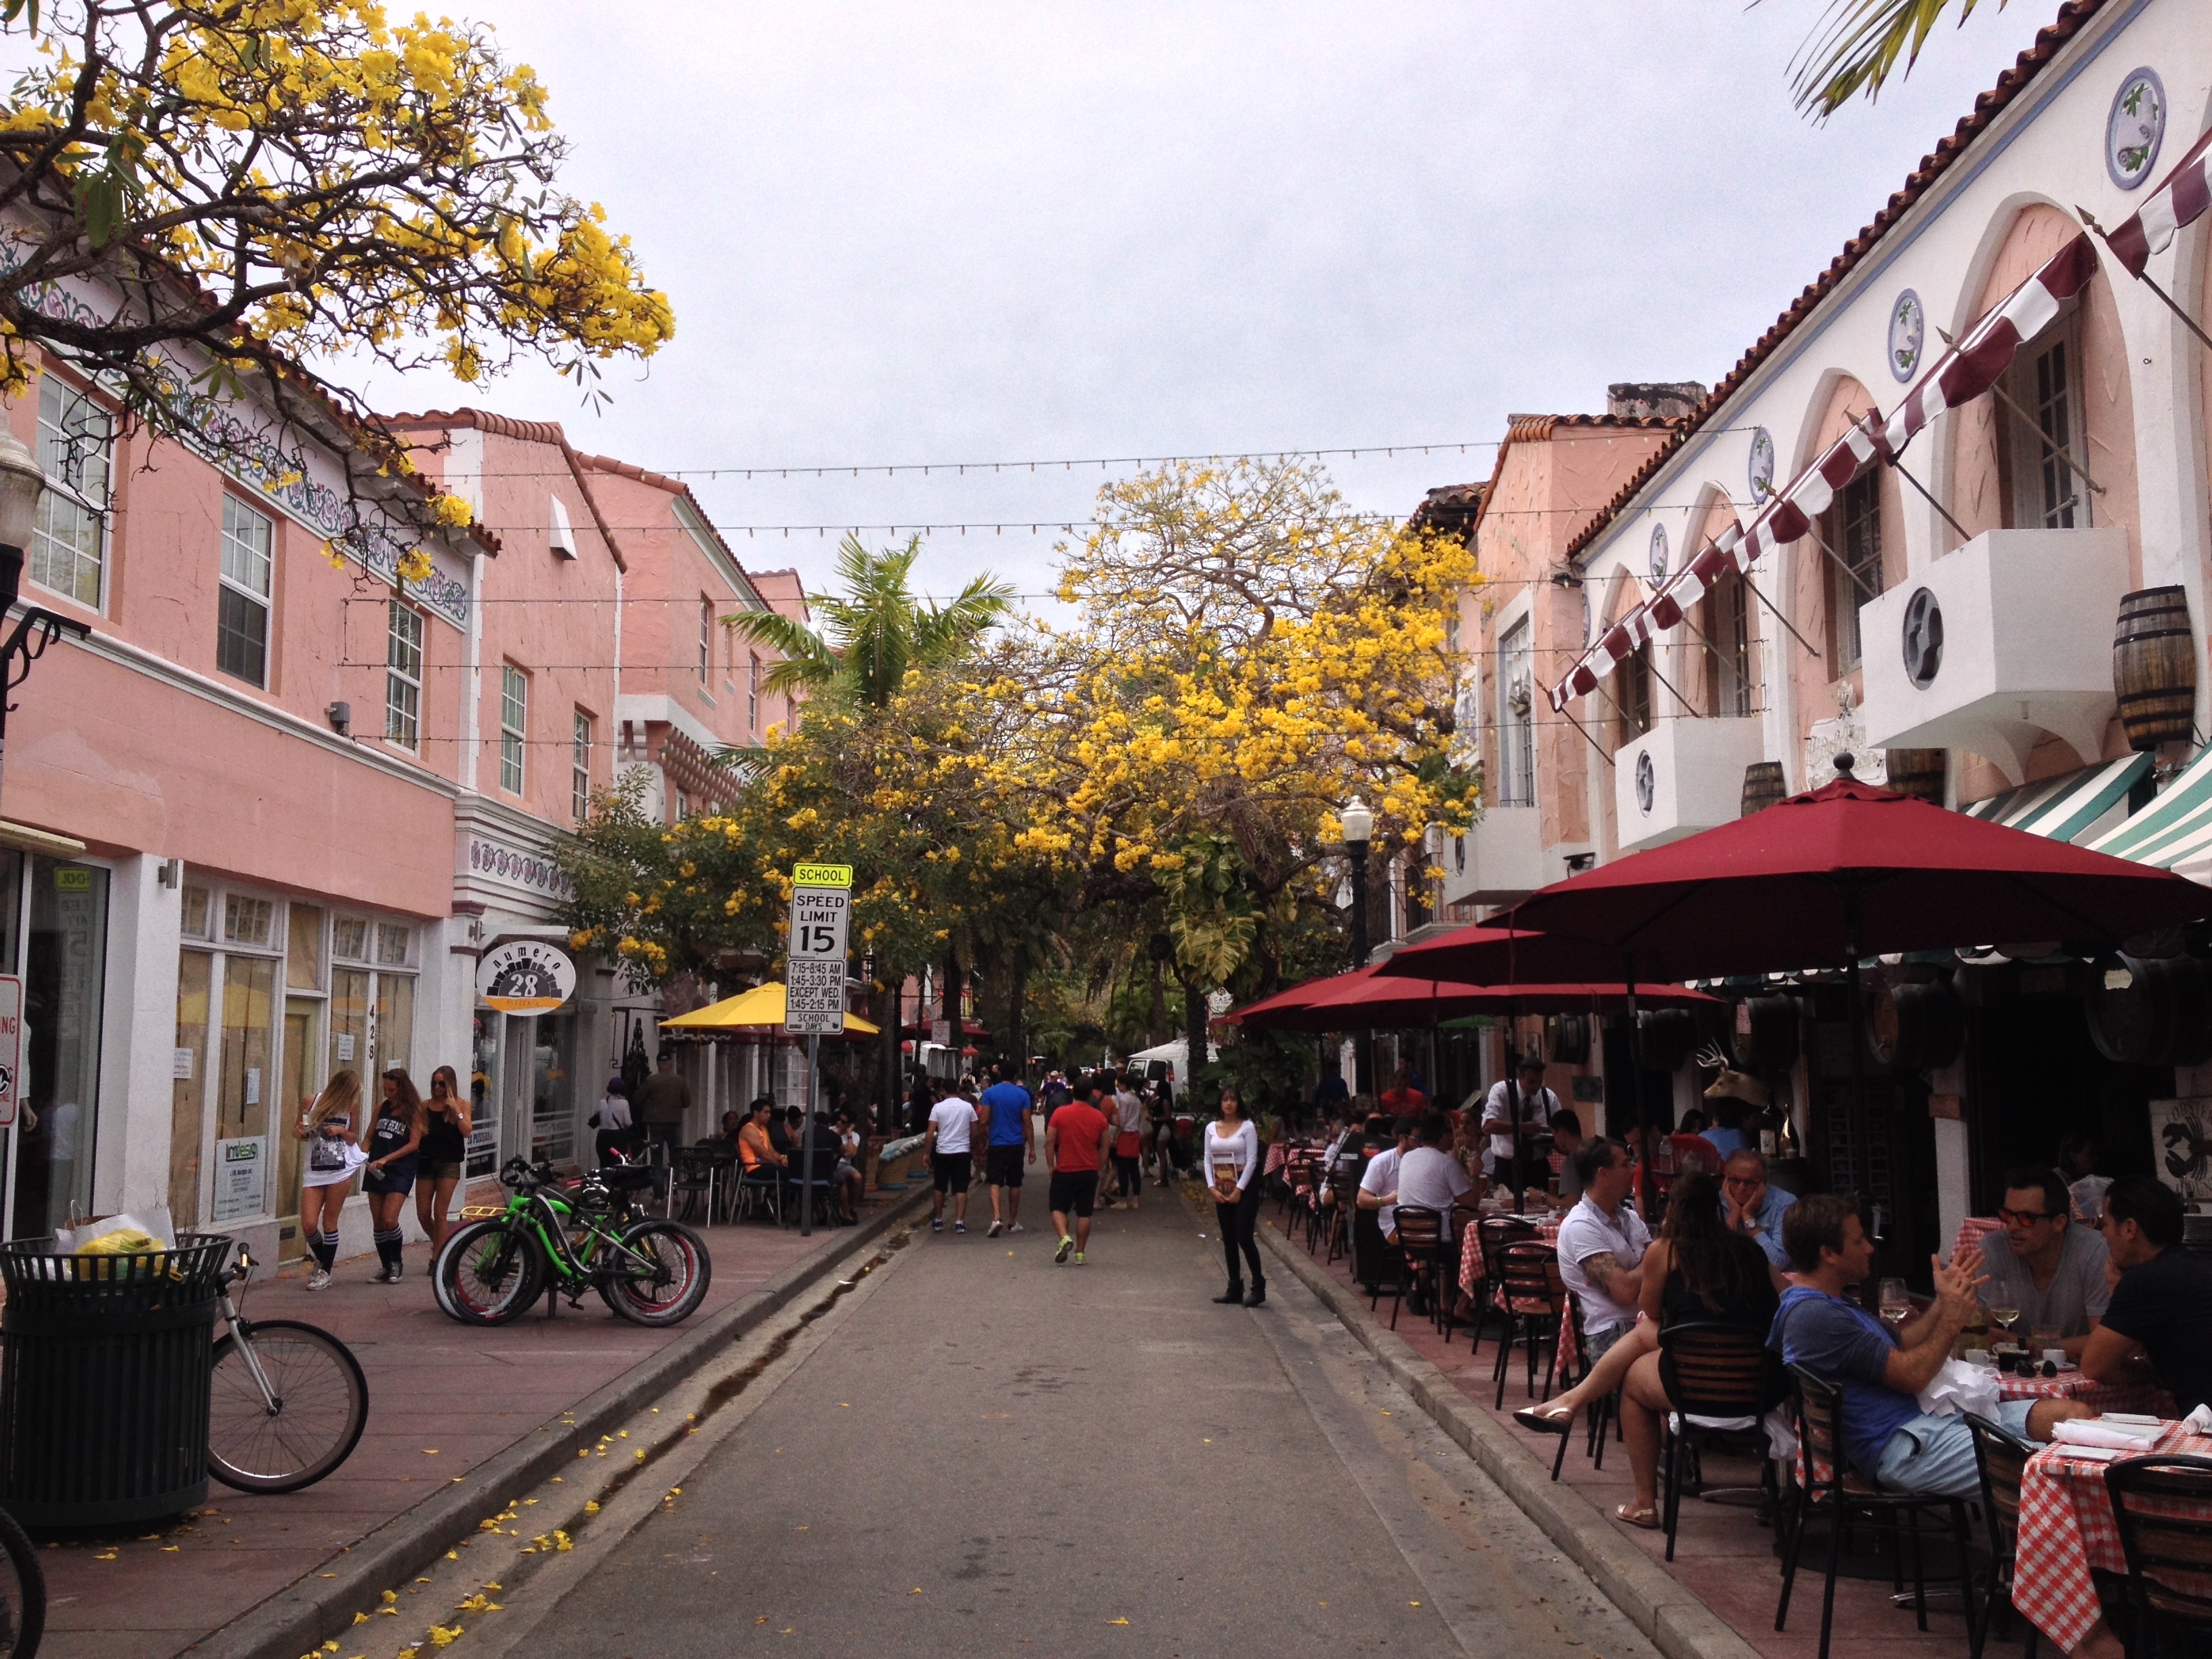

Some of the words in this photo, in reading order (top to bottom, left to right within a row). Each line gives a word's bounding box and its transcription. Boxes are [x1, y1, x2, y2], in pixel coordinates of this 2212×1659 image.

[800, 869, 844, 881] SCHOOL
[797, 895, 844, 907] SPEED
[800, 910, 838, 922] LIMIT
[800, 926, 835, 953] 15
[493, 946, 561, 970] numero
[792, 962, 826, 974] 7:15-8:45
[829, 963, 840, 974] AM
[508, 973, 538, 997] 28
[791, 975, 827, 986] 1:45-3:30
[830, 976, 840, 986] PM
[790, 987, 819, 998] EXCEPT
[821, 987, 840, 998] WED.
[791, 999, 825, 1010] 1:45-2:15
[827, 999, 839, 1010] PM
[798, 1014, 830, 1023] SCHOOL
[806, 1022, 822, 1031] DAYS
